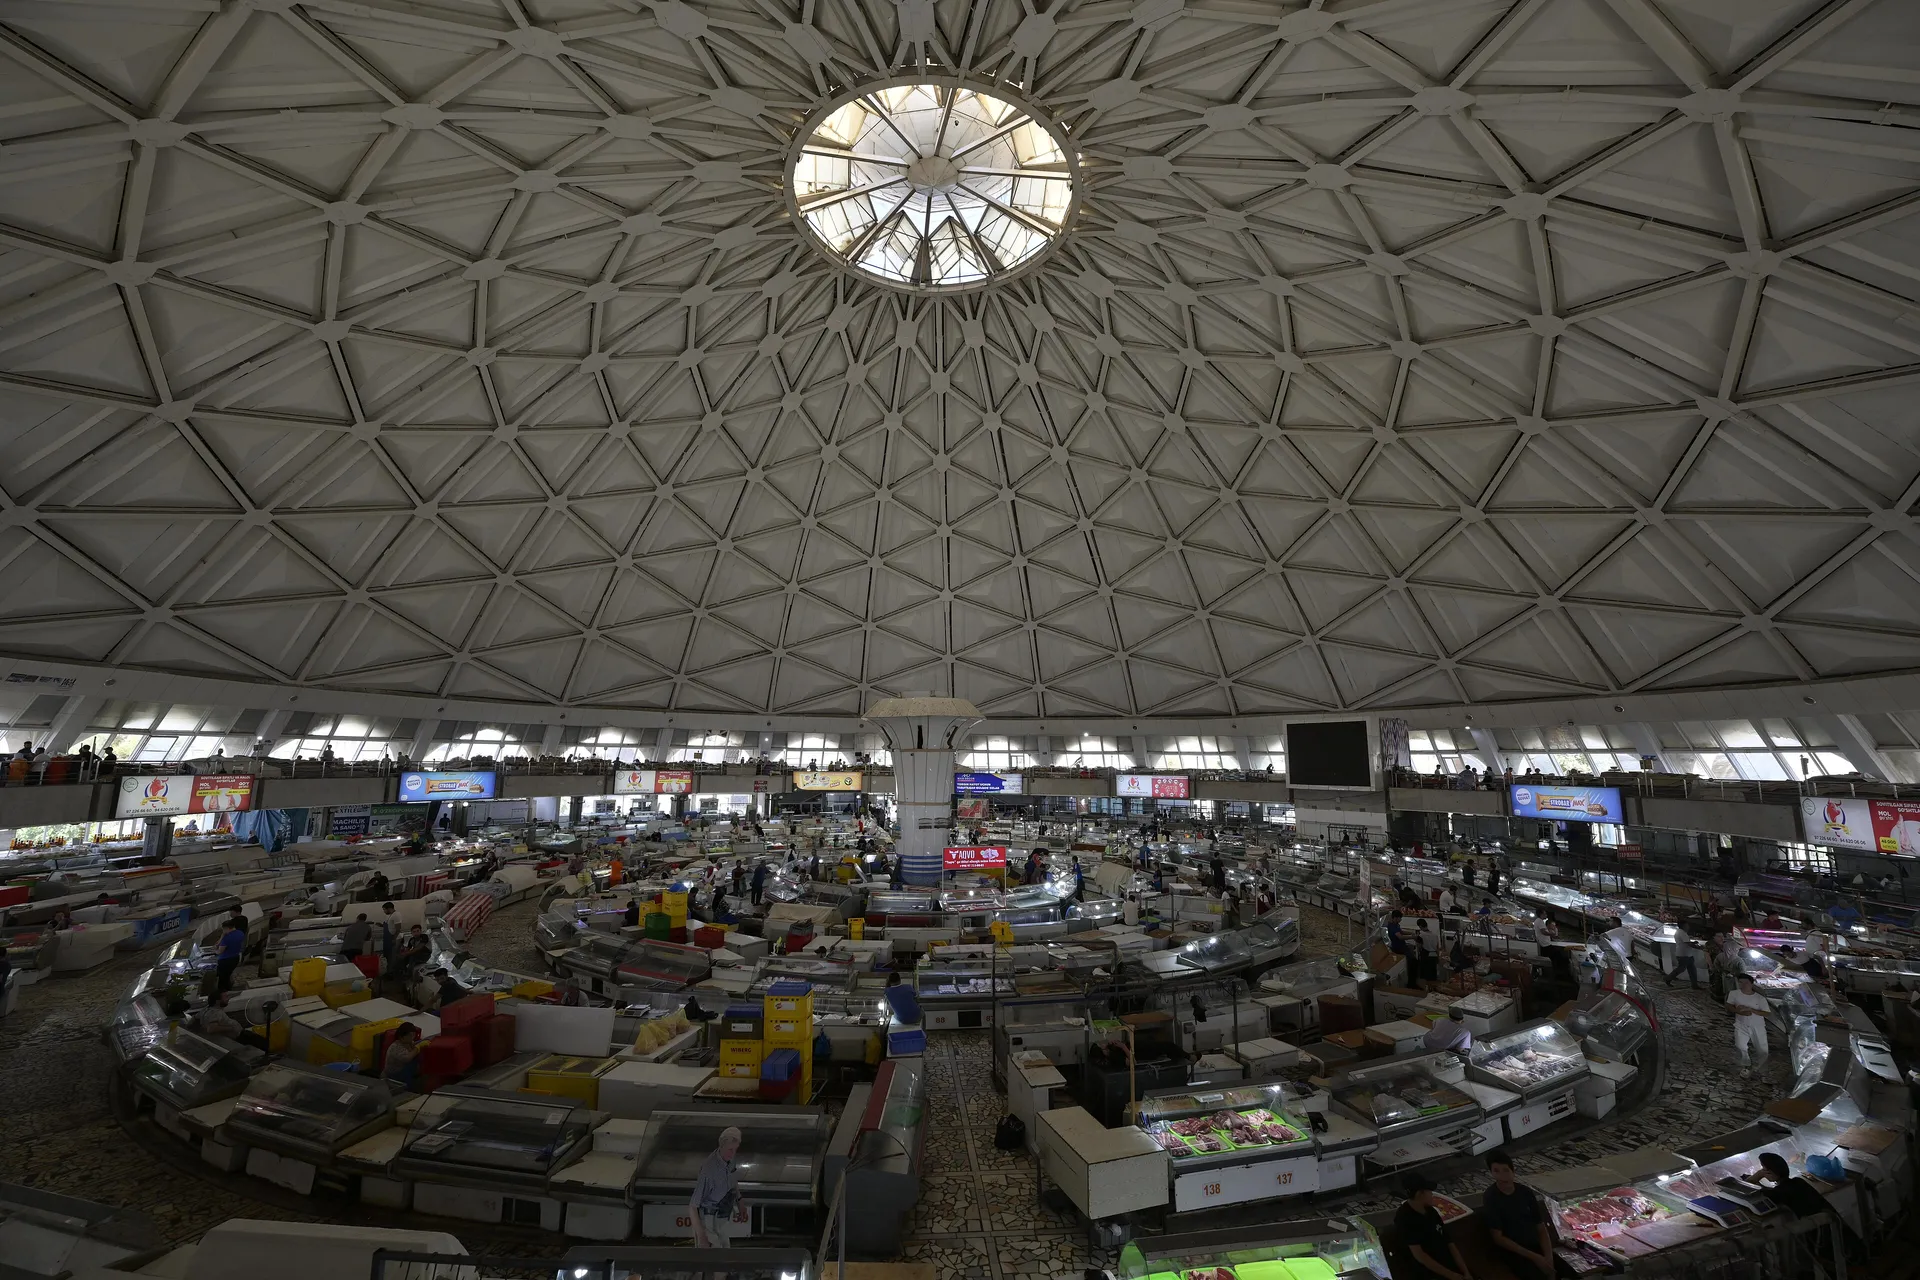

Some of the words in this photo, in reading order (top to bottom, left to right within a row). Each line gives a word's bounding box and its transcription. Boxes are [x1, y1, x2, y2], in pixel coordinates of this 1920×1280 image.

[1550, 799, 1571, 807] STROBAR
[1572, 799, 1585, 807] MAX
[162, 918, 181, 931] UGUR
[935, 1016, 946, 1024] 88
[1276, 1173, 1292, 1185] 137
[1203, 1184, 1220, 1196] 138
[676, 1217, 692, 1227] 60
